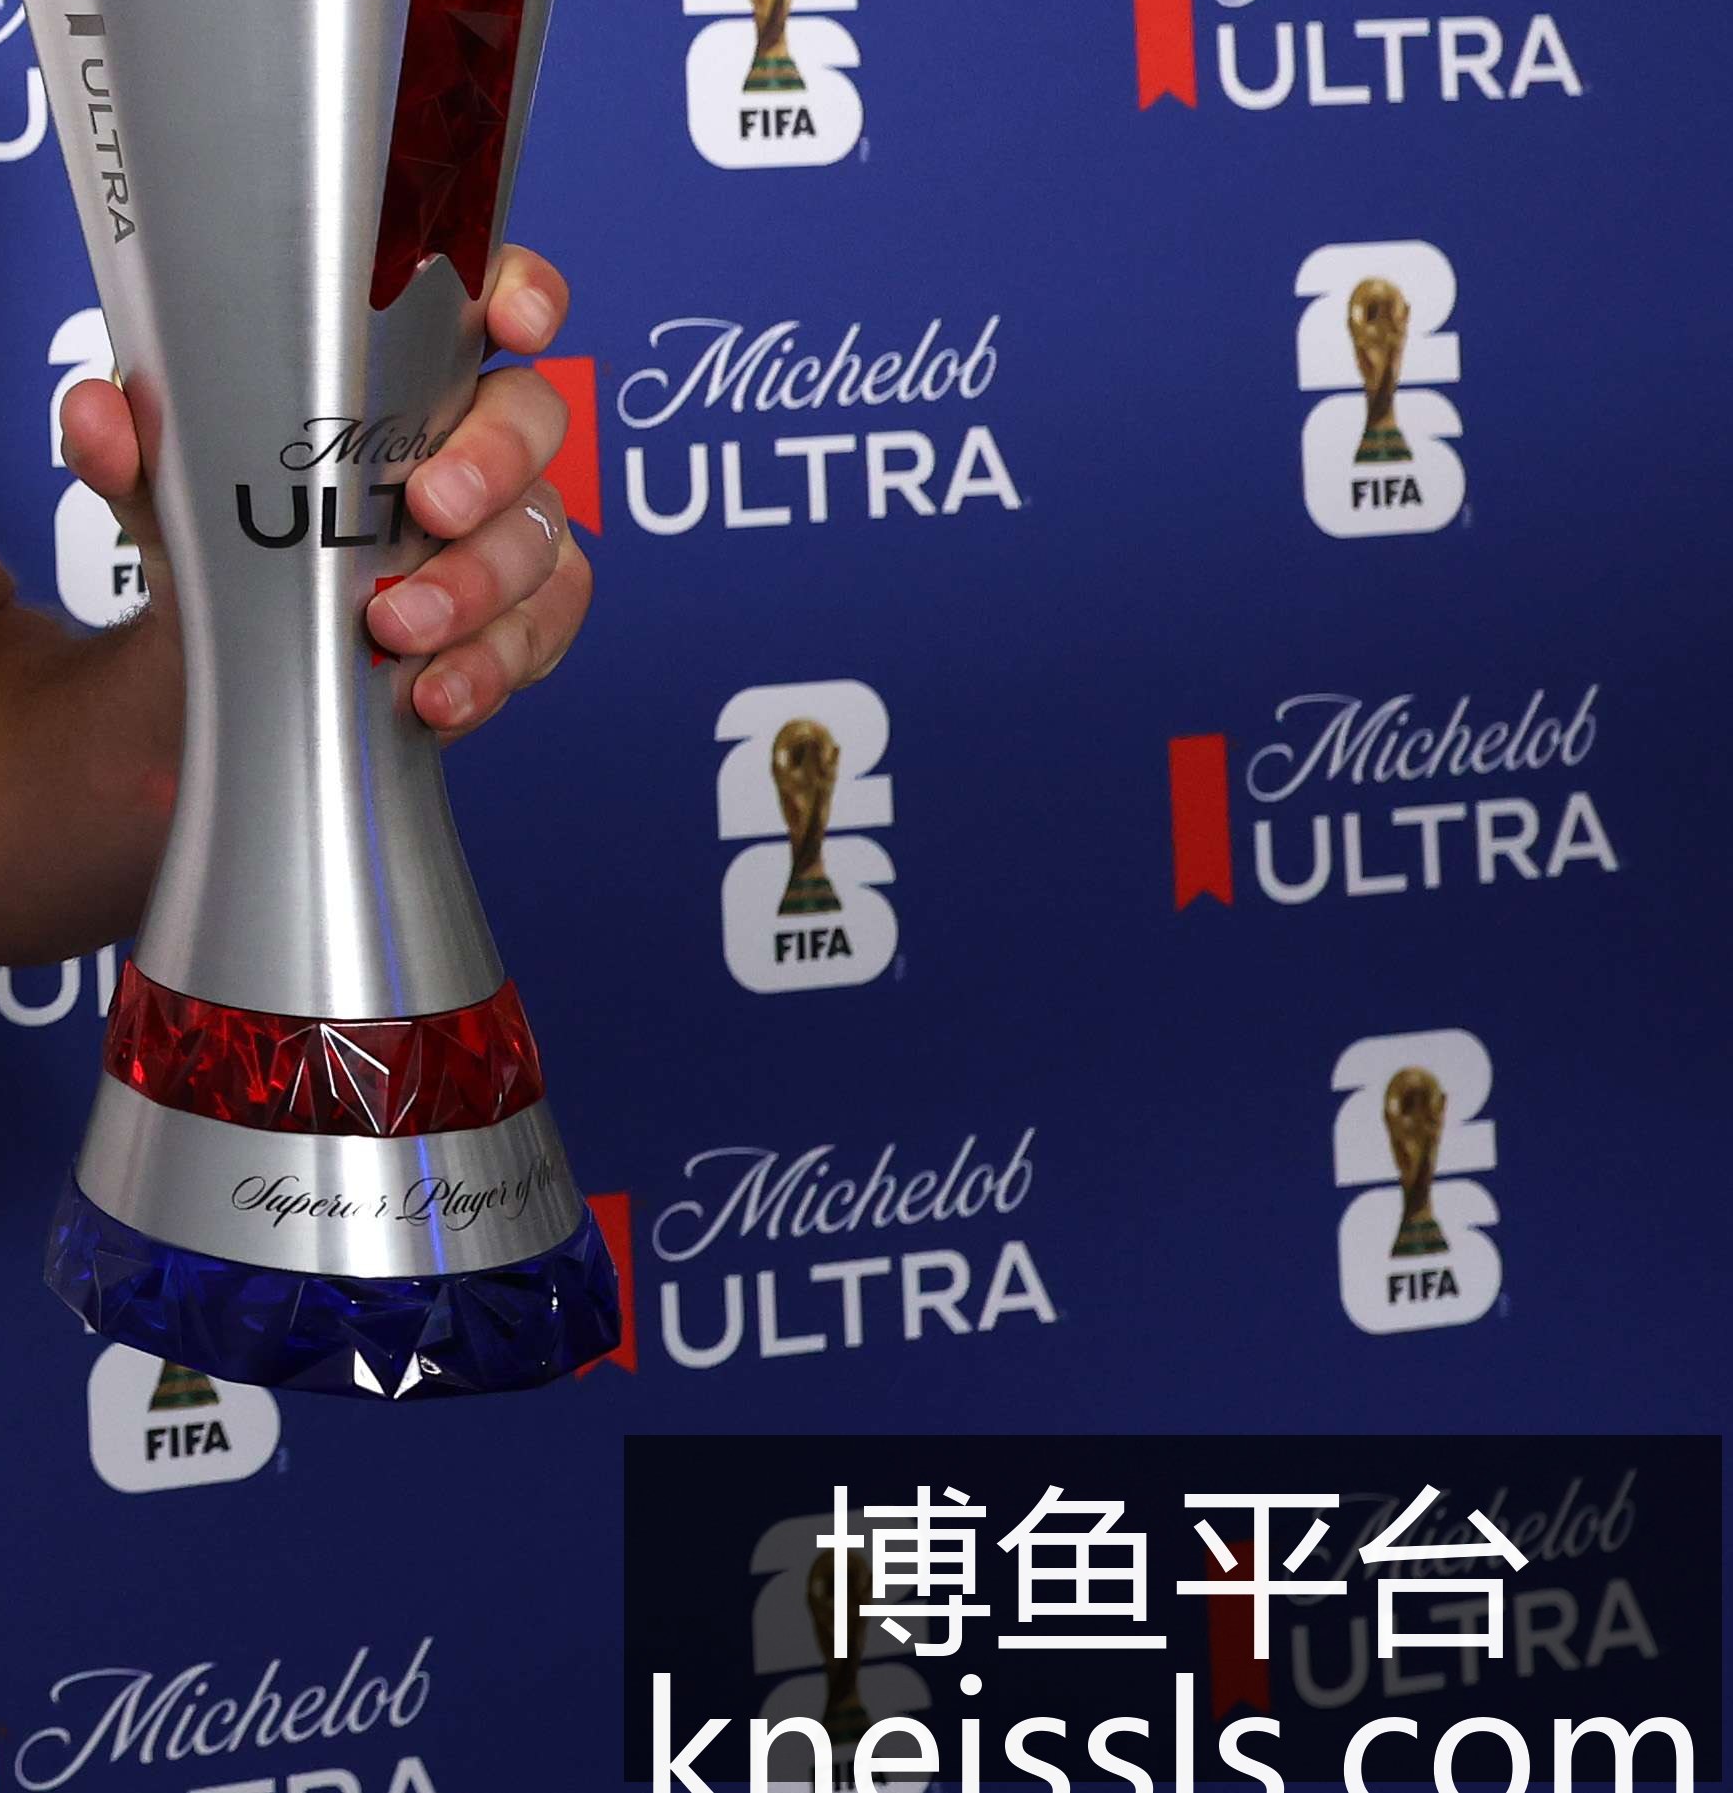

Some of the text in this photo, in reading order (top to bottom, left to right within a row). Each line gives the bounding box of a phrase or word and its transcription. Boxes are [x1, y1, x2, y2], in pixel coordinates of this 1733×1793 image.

[1216, 14, 1583, 110] ULTRA
[80, 58, 136, 244] ULTRA
[739, 107, 817, 140] FIFA
[617, 314, 1000, 428] Michelob
[235, 482, 408, 549] ULT
[624, 425, 1022, 535] ULTRA
[1350, 477, 1423, 510] FIFA
[1246, 684, 1599, 803] Michelob
[1253, 792, 1619, 905] ULTRA
[774, 926, 853, 964] FIFA
[396, 1175, 511, 1232] Player
[653, 1127, 1036, 1262] Michelob
[660, 1240, 1058, 1369] ULTRA
[1387, 1268, 1460, 1305] FIFA
[145, 1420, 232, 1462] FIFA
[15, 1636, 433, 1792] Michelob
